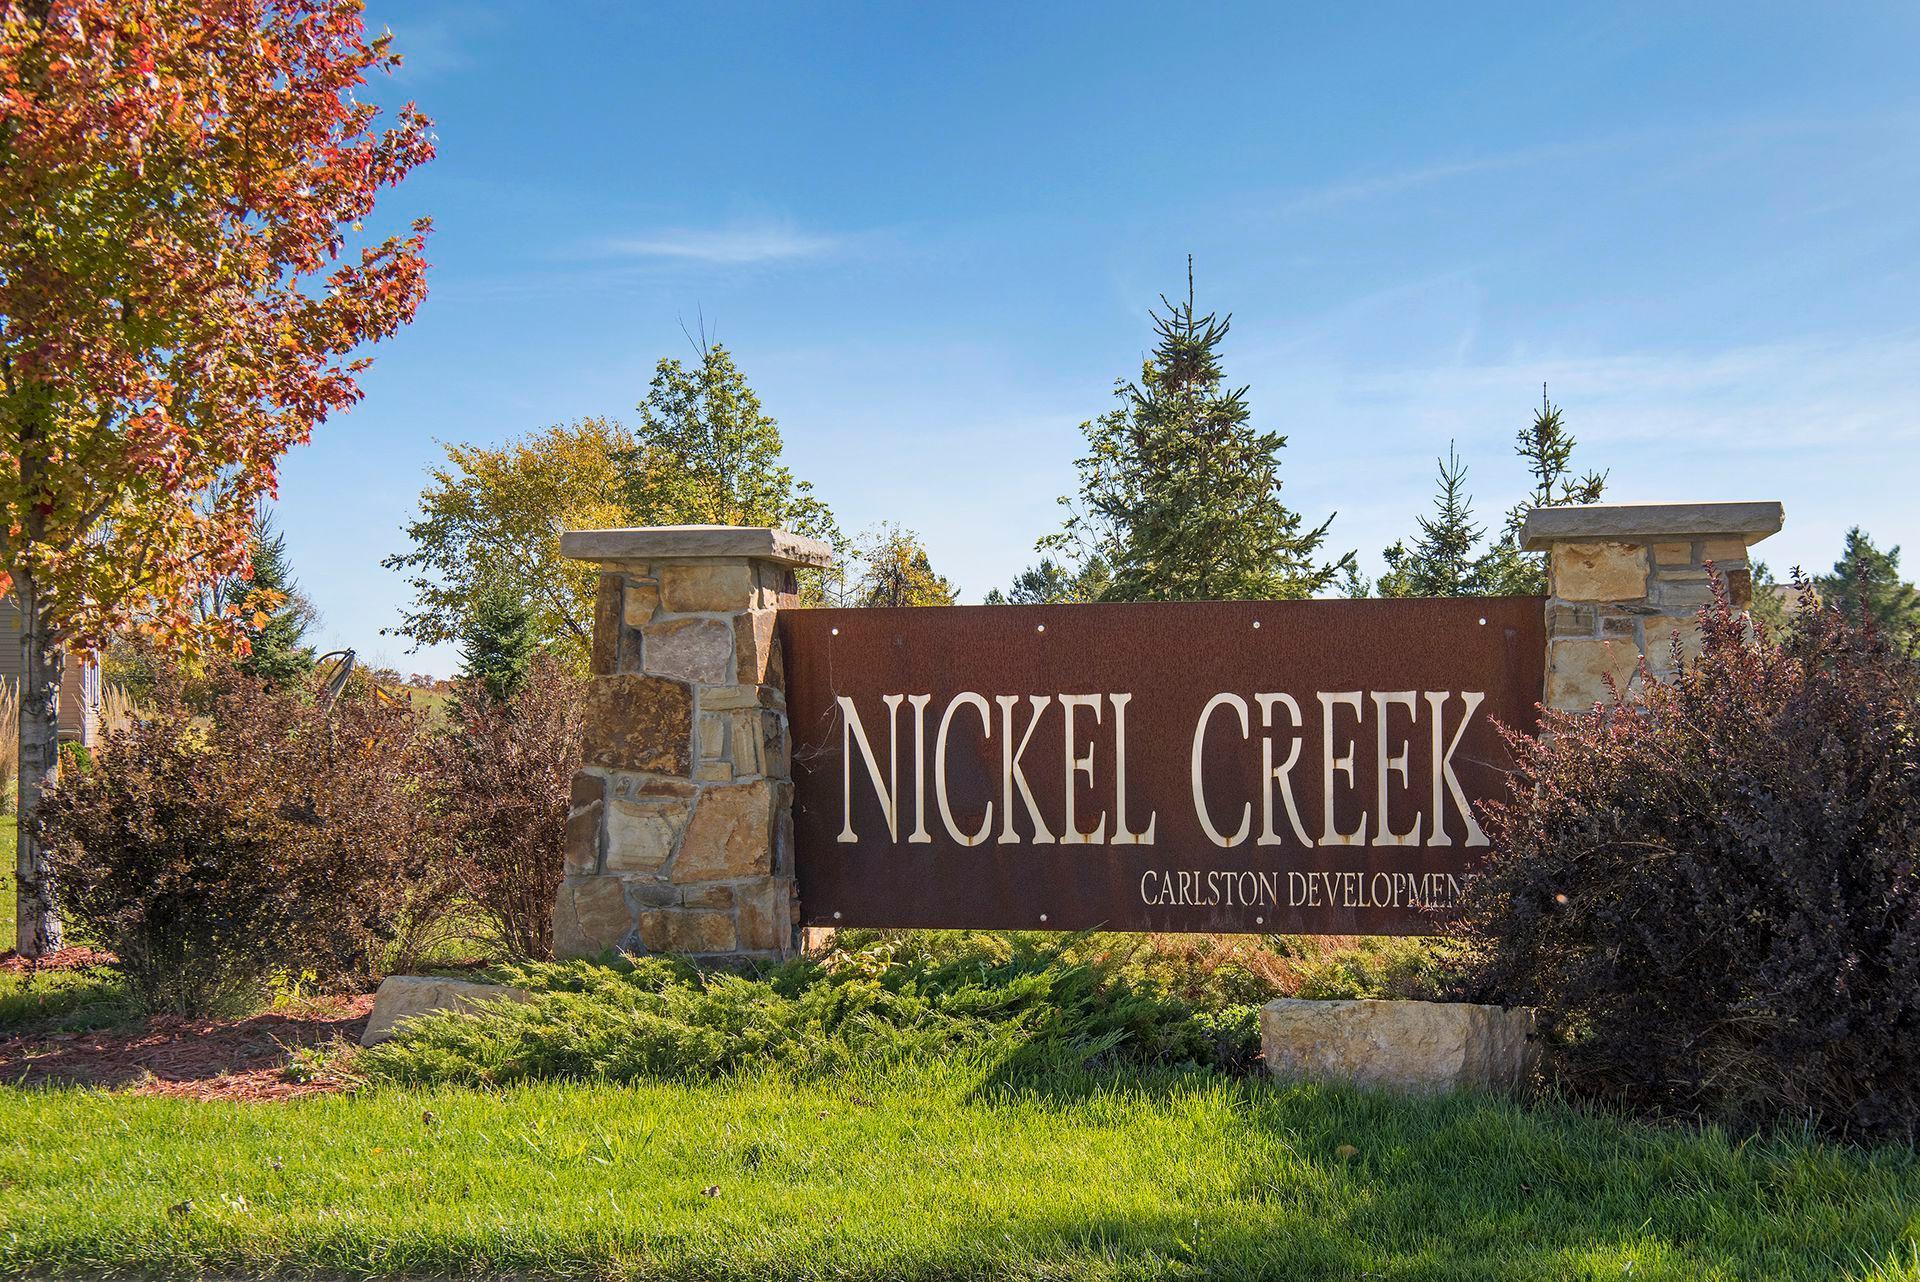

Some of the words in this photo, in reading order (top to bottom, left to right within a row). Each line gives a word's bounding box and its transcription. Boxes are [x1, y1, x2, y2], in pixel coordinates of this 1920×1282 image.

[834, 692, 1156, 847] NICKEL
[1191, 691, 1491, 848] CREEK
[1140, 870, 1278, 906] CARLSTON
[1287, 871, 1479, 908] DEVELOPMEN
